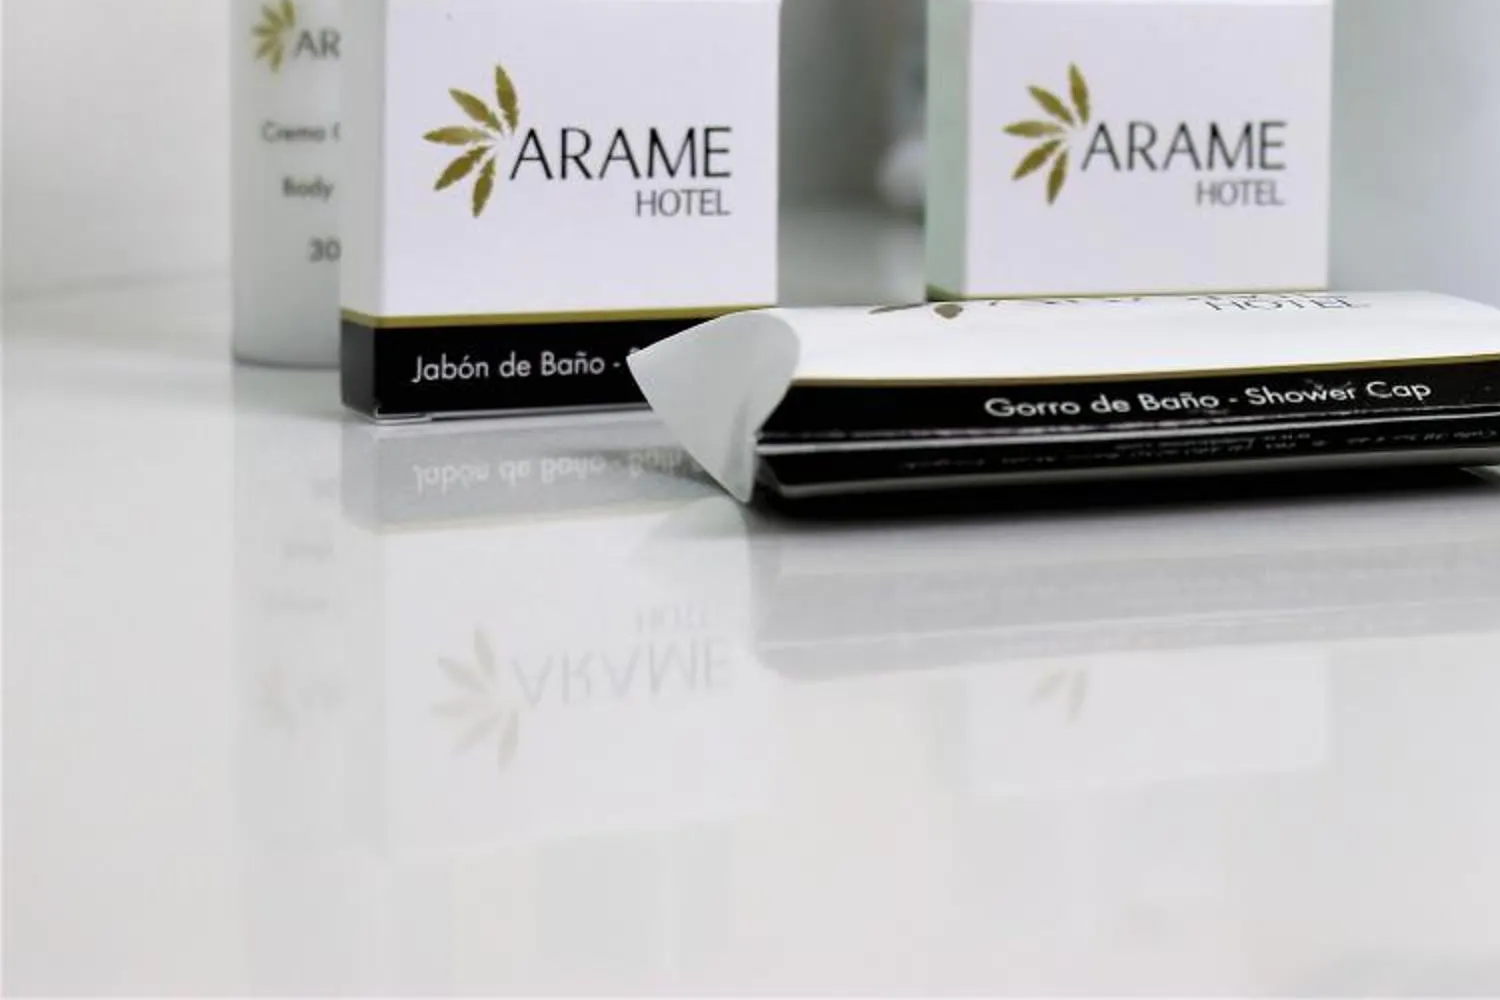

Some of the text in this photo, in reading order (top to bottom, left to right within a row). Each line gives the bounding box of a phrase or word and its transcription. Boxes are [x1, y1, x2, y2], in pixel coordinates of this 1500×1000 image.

[510, 127, 732, 180] ARAME
[1081, 121, 1287, 171] ARAME
[282, 174, 334, 203] Body
[634, 190, 732, 217] HOTEL
[1196, 180, 1286, 207] HOTEL
[308, 237, 342, 263] 30
[411, 352, 489, 383] Jabón
[499, 351, 531, 377] de
[540, 350, 605, 376] Baño
[984, 397, 1082, 417] Gorro
[1090, 392, 1130, 413] de
[1138, 391, 1220, 411] Baño
[1244, 385, 1356, 406] Shower
[1366, 380, 1431, 401] Cap
